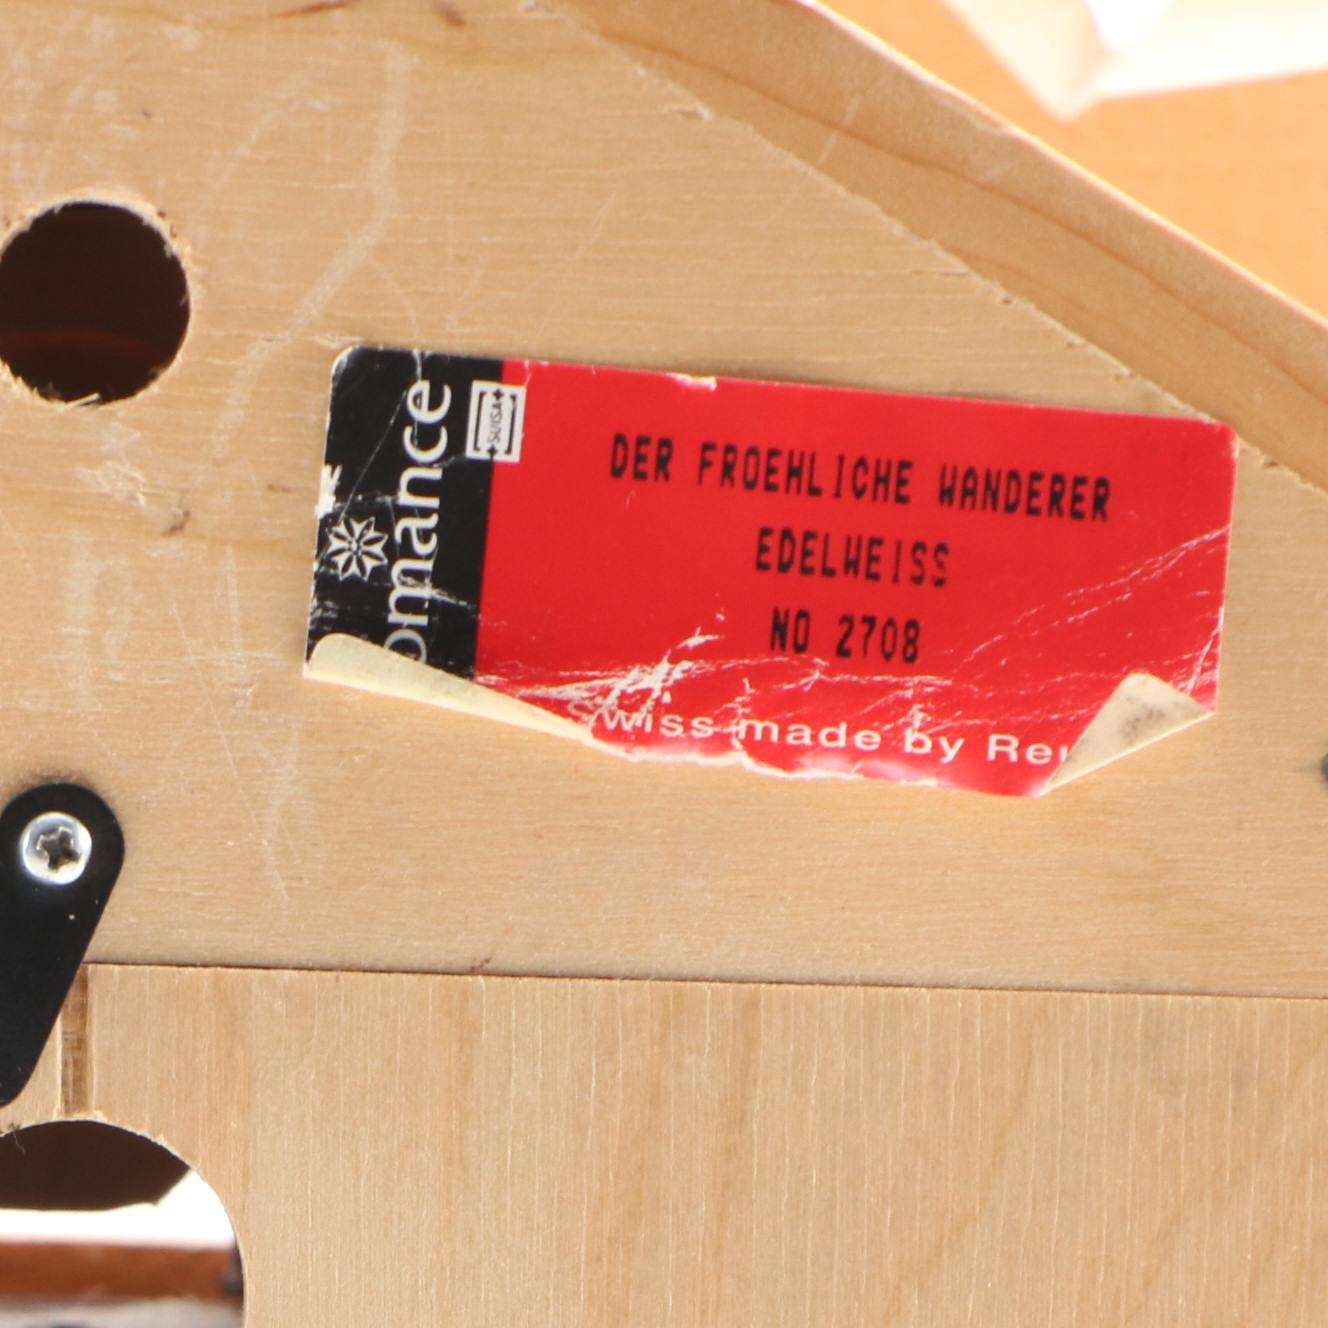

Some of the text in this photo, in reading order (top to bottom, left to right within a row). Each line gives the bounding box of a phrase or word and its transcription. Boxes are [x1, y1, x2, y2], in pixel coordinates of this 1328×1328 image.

[609, 432, 1111, 522] DER FROEHLICHE WANDERER
[754, 526, 950, 587] EDELWEISS
[771, 606, 921, 664] NO 2708
[738, 715, 882, 751] made
[903, 721, 966, 766] by
